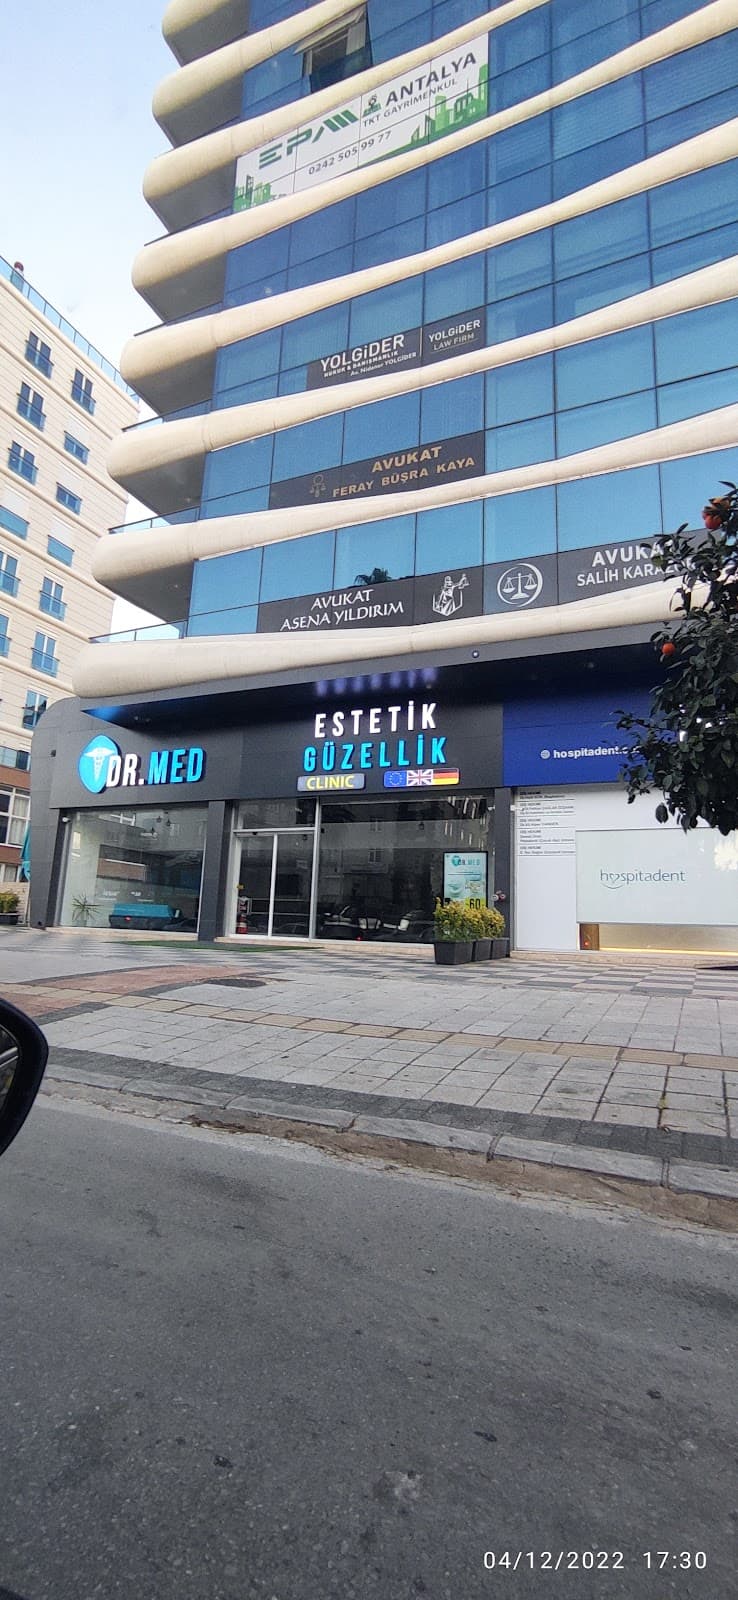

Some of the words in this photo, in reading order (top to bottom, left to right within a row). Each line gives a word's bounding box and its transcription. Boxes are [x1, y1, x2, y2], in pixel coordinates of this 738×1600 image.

[385, 52, 477, 107] ANTALYA
[362, 112, 382, 128] TKT
[308, 157, 335, 175] 0242
[338, 146, 358, 161] 505
[361, 138, 375, 151] 99
[378, 130, 392, 143] 77
[433, 339, 451, 351] LAW
[454, 332, 475, 345] FIRM
[372, 446, 443, 473] AVUKAT
[332, 480, 374, 498] FERAY
[382, 467, 429, 485] BÜŞRA
[436, 457, 475, 474] KAYA
[577, 567, 619, 587] SALİH
[310, 589, 374, 611] AVUKAT
[280, 612, 331, 632] ASENA
[335, 601, 404, 625] YILDIRIM
[314, 700, 437, 738] ESTETİK
[303, 733, 446, 772] GÜZELLİK
[106, 748, 204, 788] DR.MED
[306, 775, 355, 790] CLINIC
[600, 869, 686, 885] hospitadent
